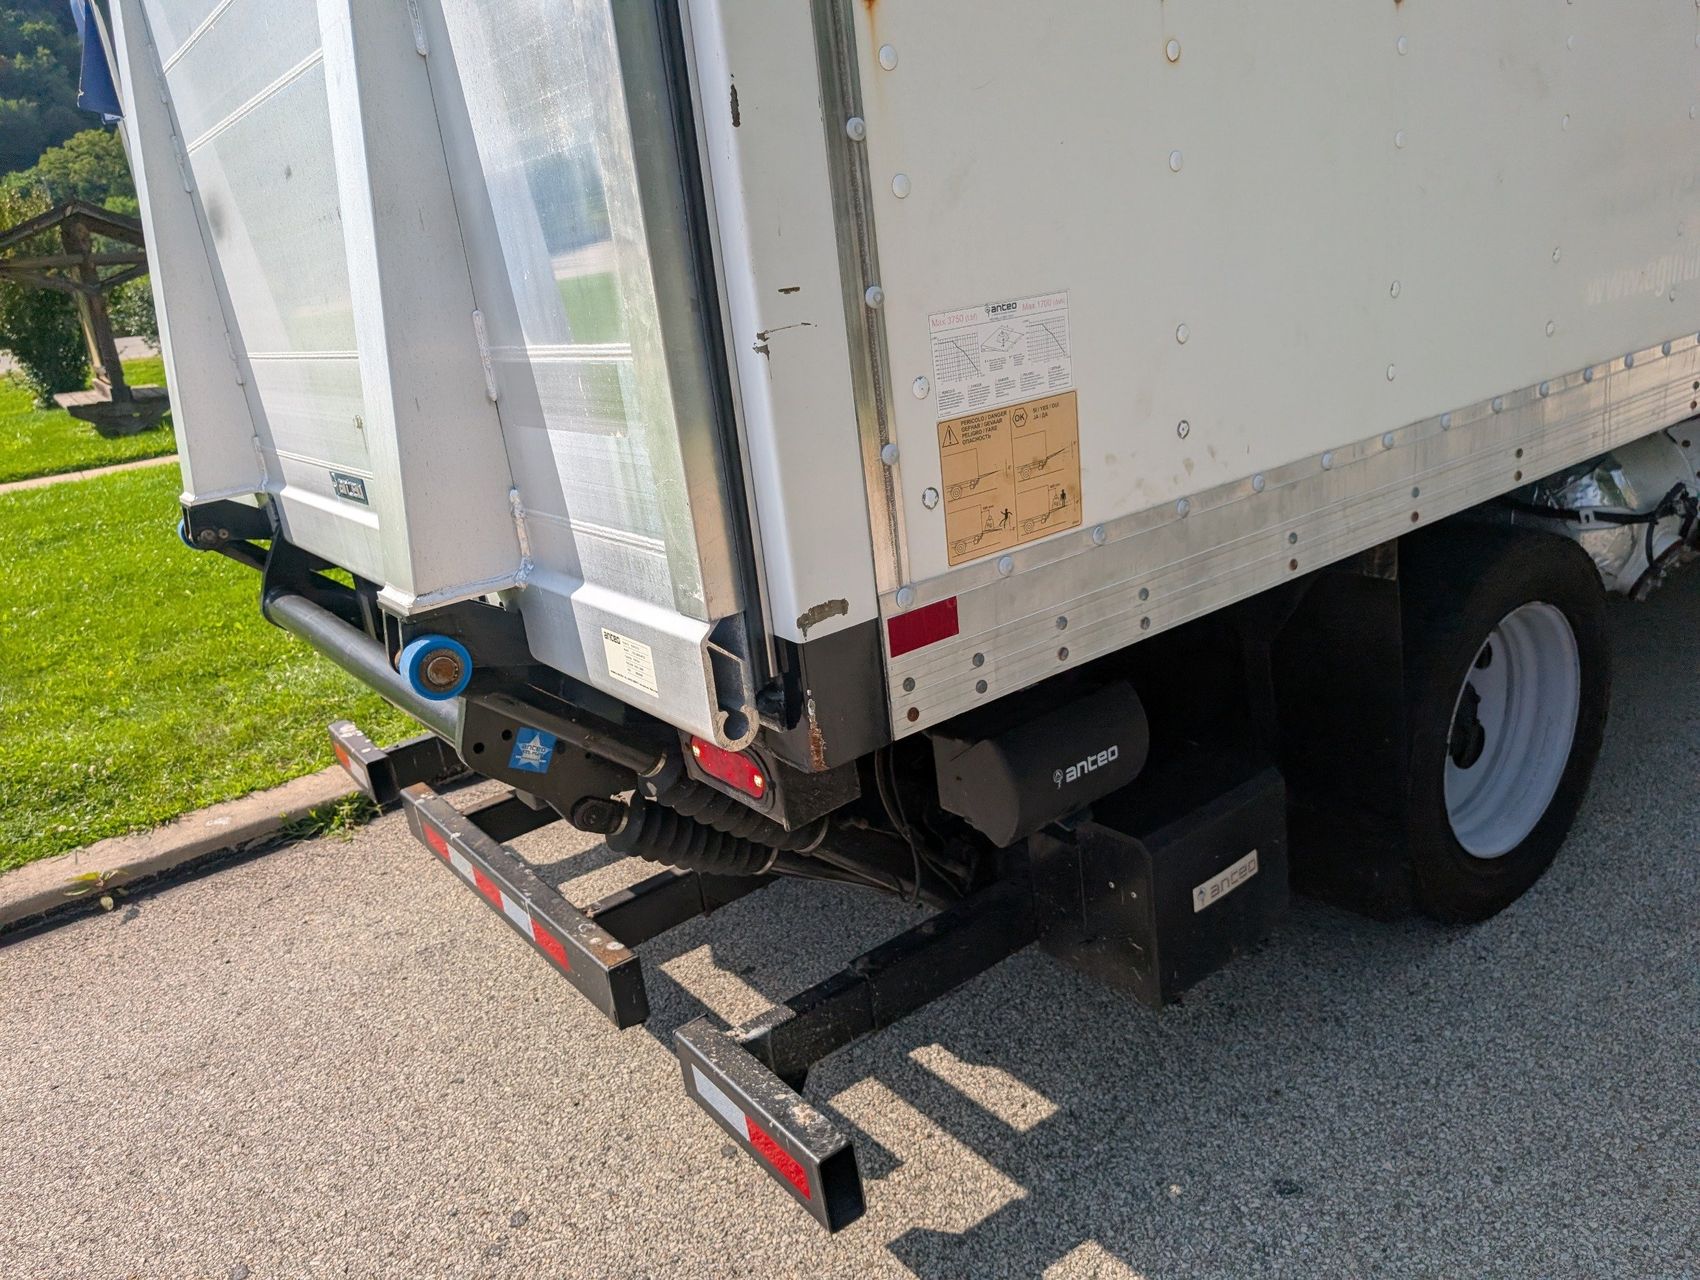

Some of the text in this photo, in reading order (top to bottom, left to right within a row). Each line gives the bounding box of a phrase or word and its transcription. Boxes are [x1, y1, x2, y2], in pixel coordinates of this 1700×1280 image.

[991, 302, 1018, 313] anteo
[1022, 301, 1035, 311] Max
[931, 317, 946, 327] Max
[946, 314, 964, 325] 3750
[961, 416, 984, 425] PERICOLO
[988, 411, 1007, 419] DANGER
[1015, 413, 1024, 422] OK
[1065, 745, 1119, 783] anteo
[1210, 858, 1256, 898] anteo
